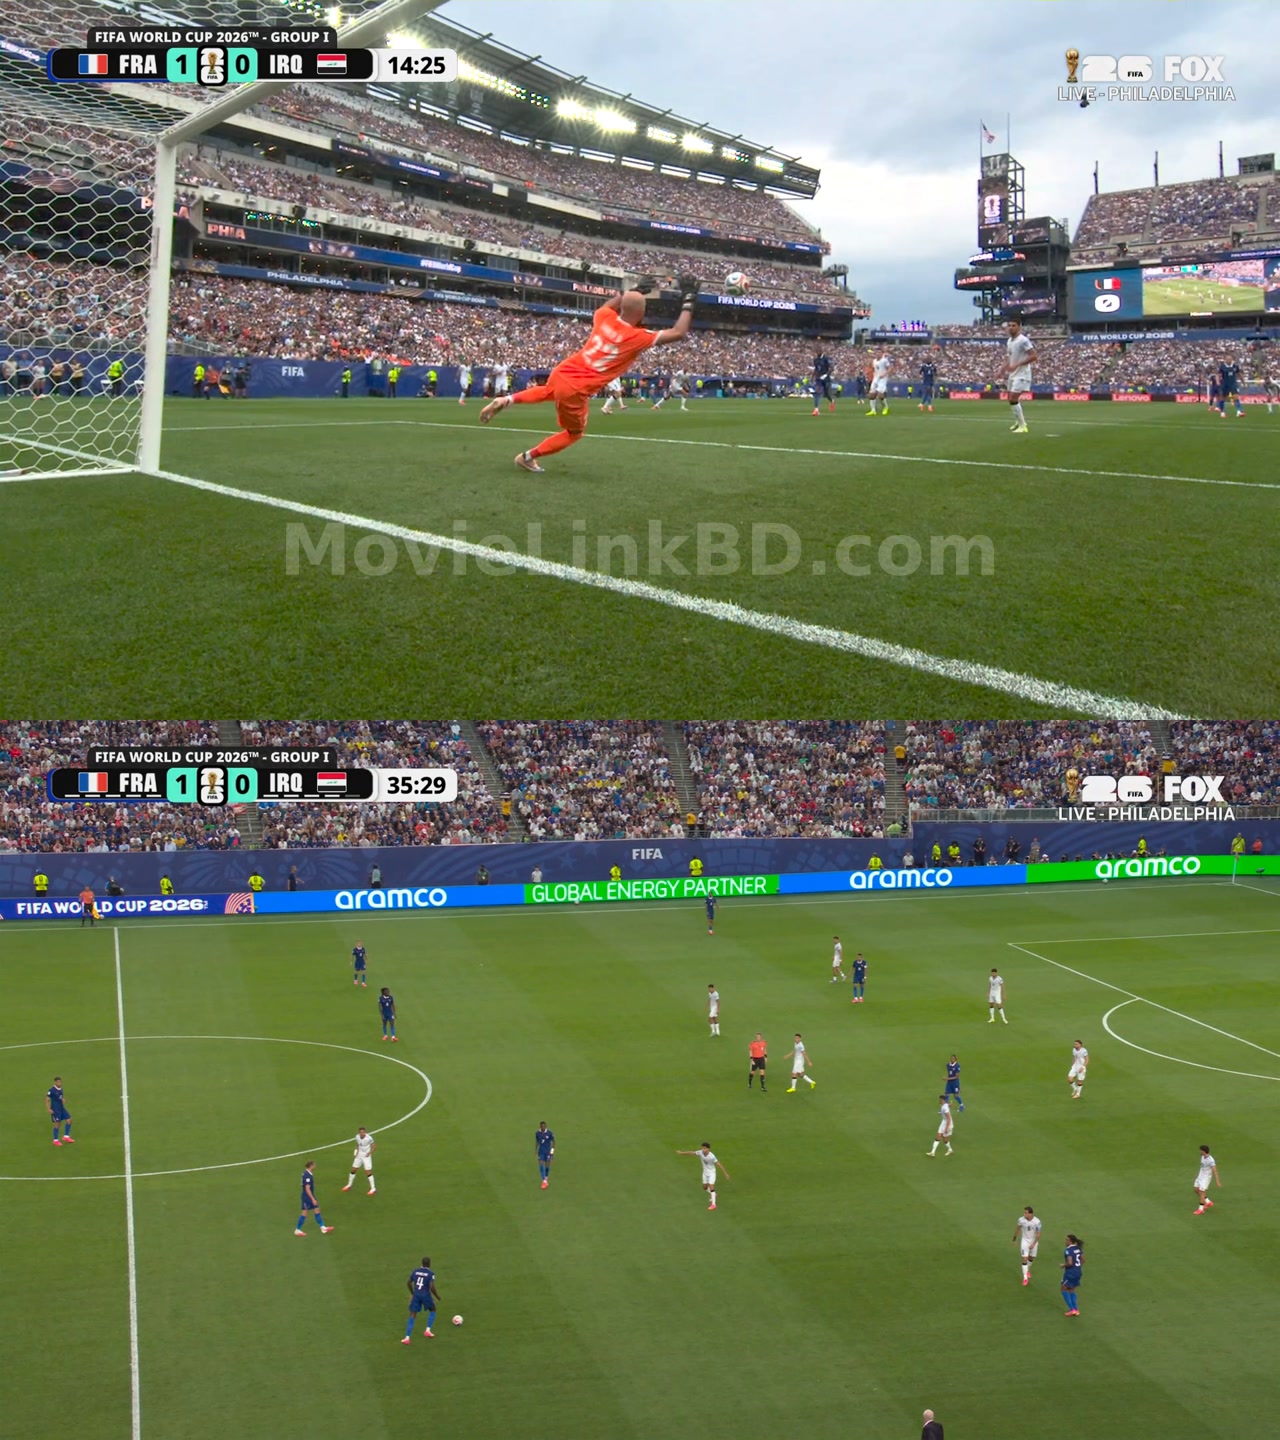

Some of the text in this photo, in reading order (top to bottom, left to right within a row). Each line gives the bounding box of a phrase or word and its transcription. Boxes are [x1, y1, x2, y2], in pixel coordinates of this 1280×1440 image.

[267, 271, 344, 287] PHILADELPHIA
[717, 296, 797, 310] FIFA WORLD CUP 2026
[281, 365, 305, 377] FIFA
[950, 392, 979, 400] Lenovo
[1054, 393, 1089, 401] Lenovo
[1113, 393, 1150, 402] Lenovo
[631, 847, 663, 860] FIFA
[1095, 856, 1201, 878] aramco
[849, 868, 953, 889] aramco
[532, 876, 767, 902] GLOBAL ENERGY PARTNER
[335, 887, 448, 909] aramco
[17, 902, 51, 914] FIFA
[54, 901, 113, 914] WOLD
[115, 900, 148, 913] CUP
[416, 1276, 424, 1290] 4
